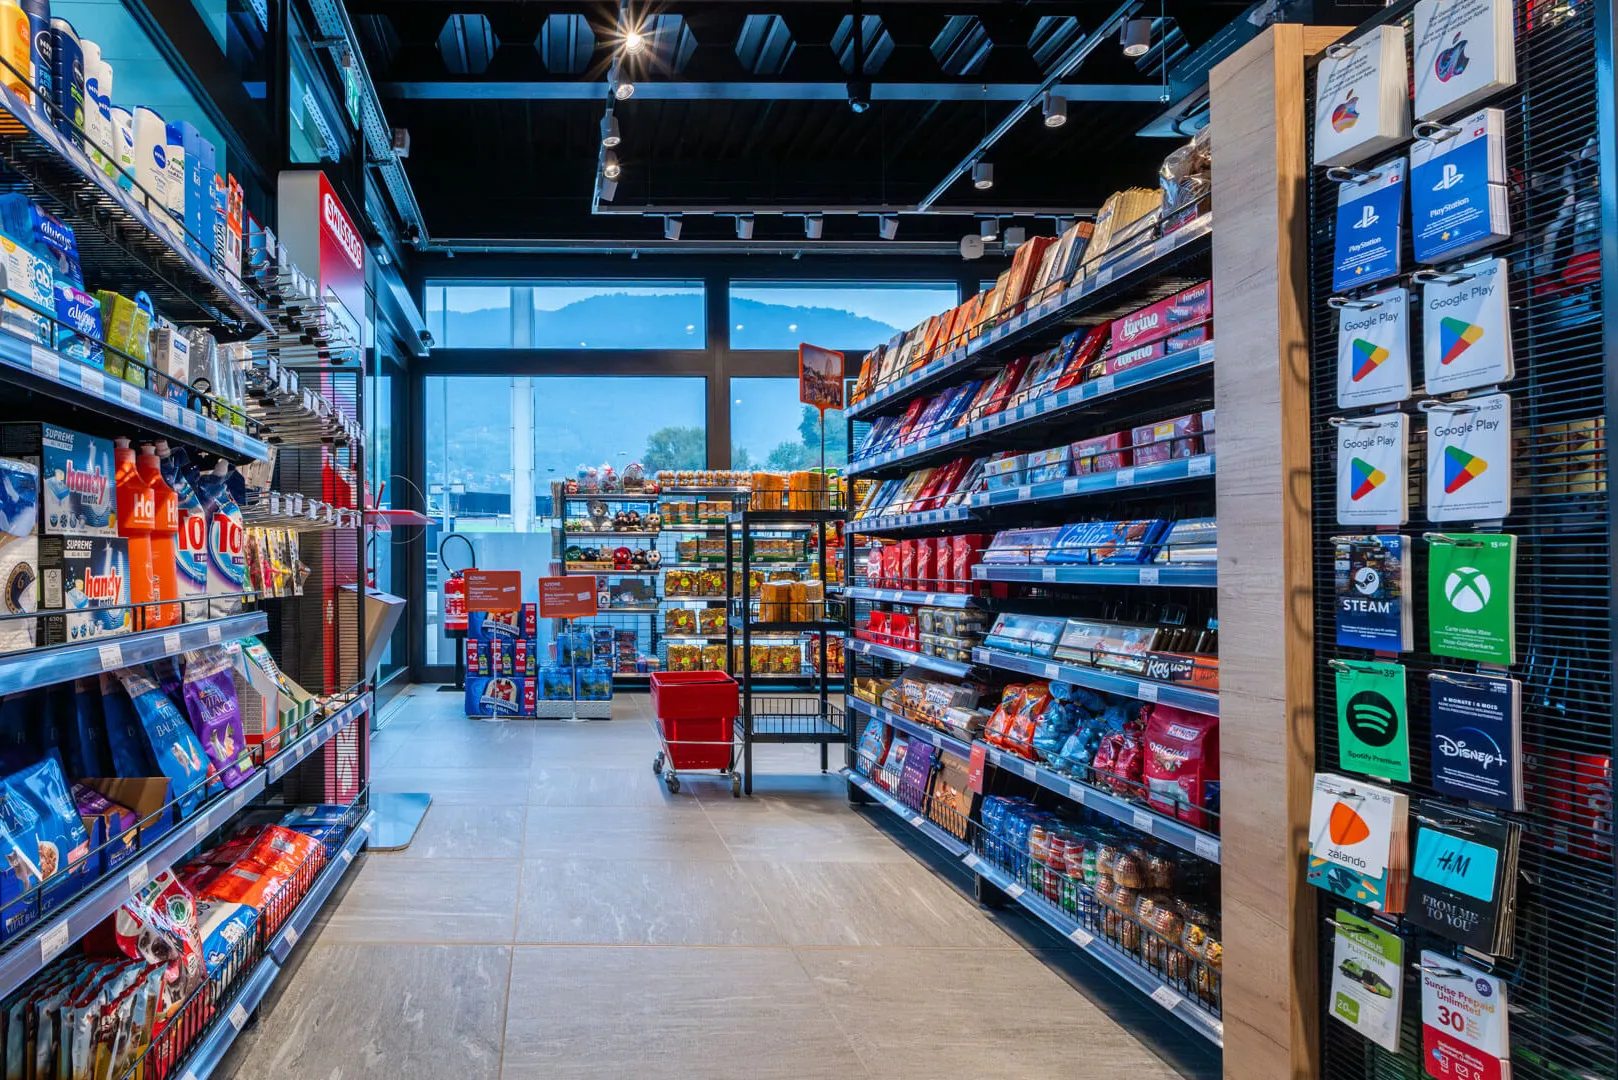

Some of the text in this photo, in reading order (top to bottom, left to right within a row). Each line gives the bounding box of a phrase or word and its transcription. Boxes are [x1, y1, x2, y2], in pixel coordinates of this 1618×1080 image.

[1430, 197, 1470, 218] PlayStation
[41, 221, 73, 251] always
[326, 194, 361, 268] SWISSLOS
[1348, 236, 1382, 253] PlayStation
[1430, 284, 1495, 311] Google Play
[68, 303, 97, 329] always
[1120, 311, 1160, 339] torino
[1344, 311, 1399, 332] Google Play
[45, 428, 75, 444] SUPREME
[1434, 418, 1500, 438] Google Play
[1343, 435, 1396, 450] Google Play
[66, 460, 108, 506] handy
[66, 539, 93, 550] SUPREME
[1057, 523, 1109, 546] Cailler
[85, 567, 122, 606] handy
[1343, 599, 1391, 614] STEAM
[526, 615, 535, 624] +2
[468, 652, 478, 662] +2
[515, 652, 525, 662] +2
[1146, 656, 1193, 679] Ragusa
[525, 691, 534, 701] +2
[201, 700, 235, 722] BALANCE
[1168, 725, 1199, 740] MINOR
[1347, 749, 1402, 767] Spotify Premium
[1327, 848, 1366, 869] zalando
[1437, 849, 1472, 878] H&M
[1422, 893, 1479, 924] FROM ME
[1426, 905, 1472, 932] TO YOU
[1424, 976, 1495, 1014] Sunrise Prepaid
[1437, 990, 1481, 1017] Unlimited
[1437, 1005, 1465, 1032] 30
